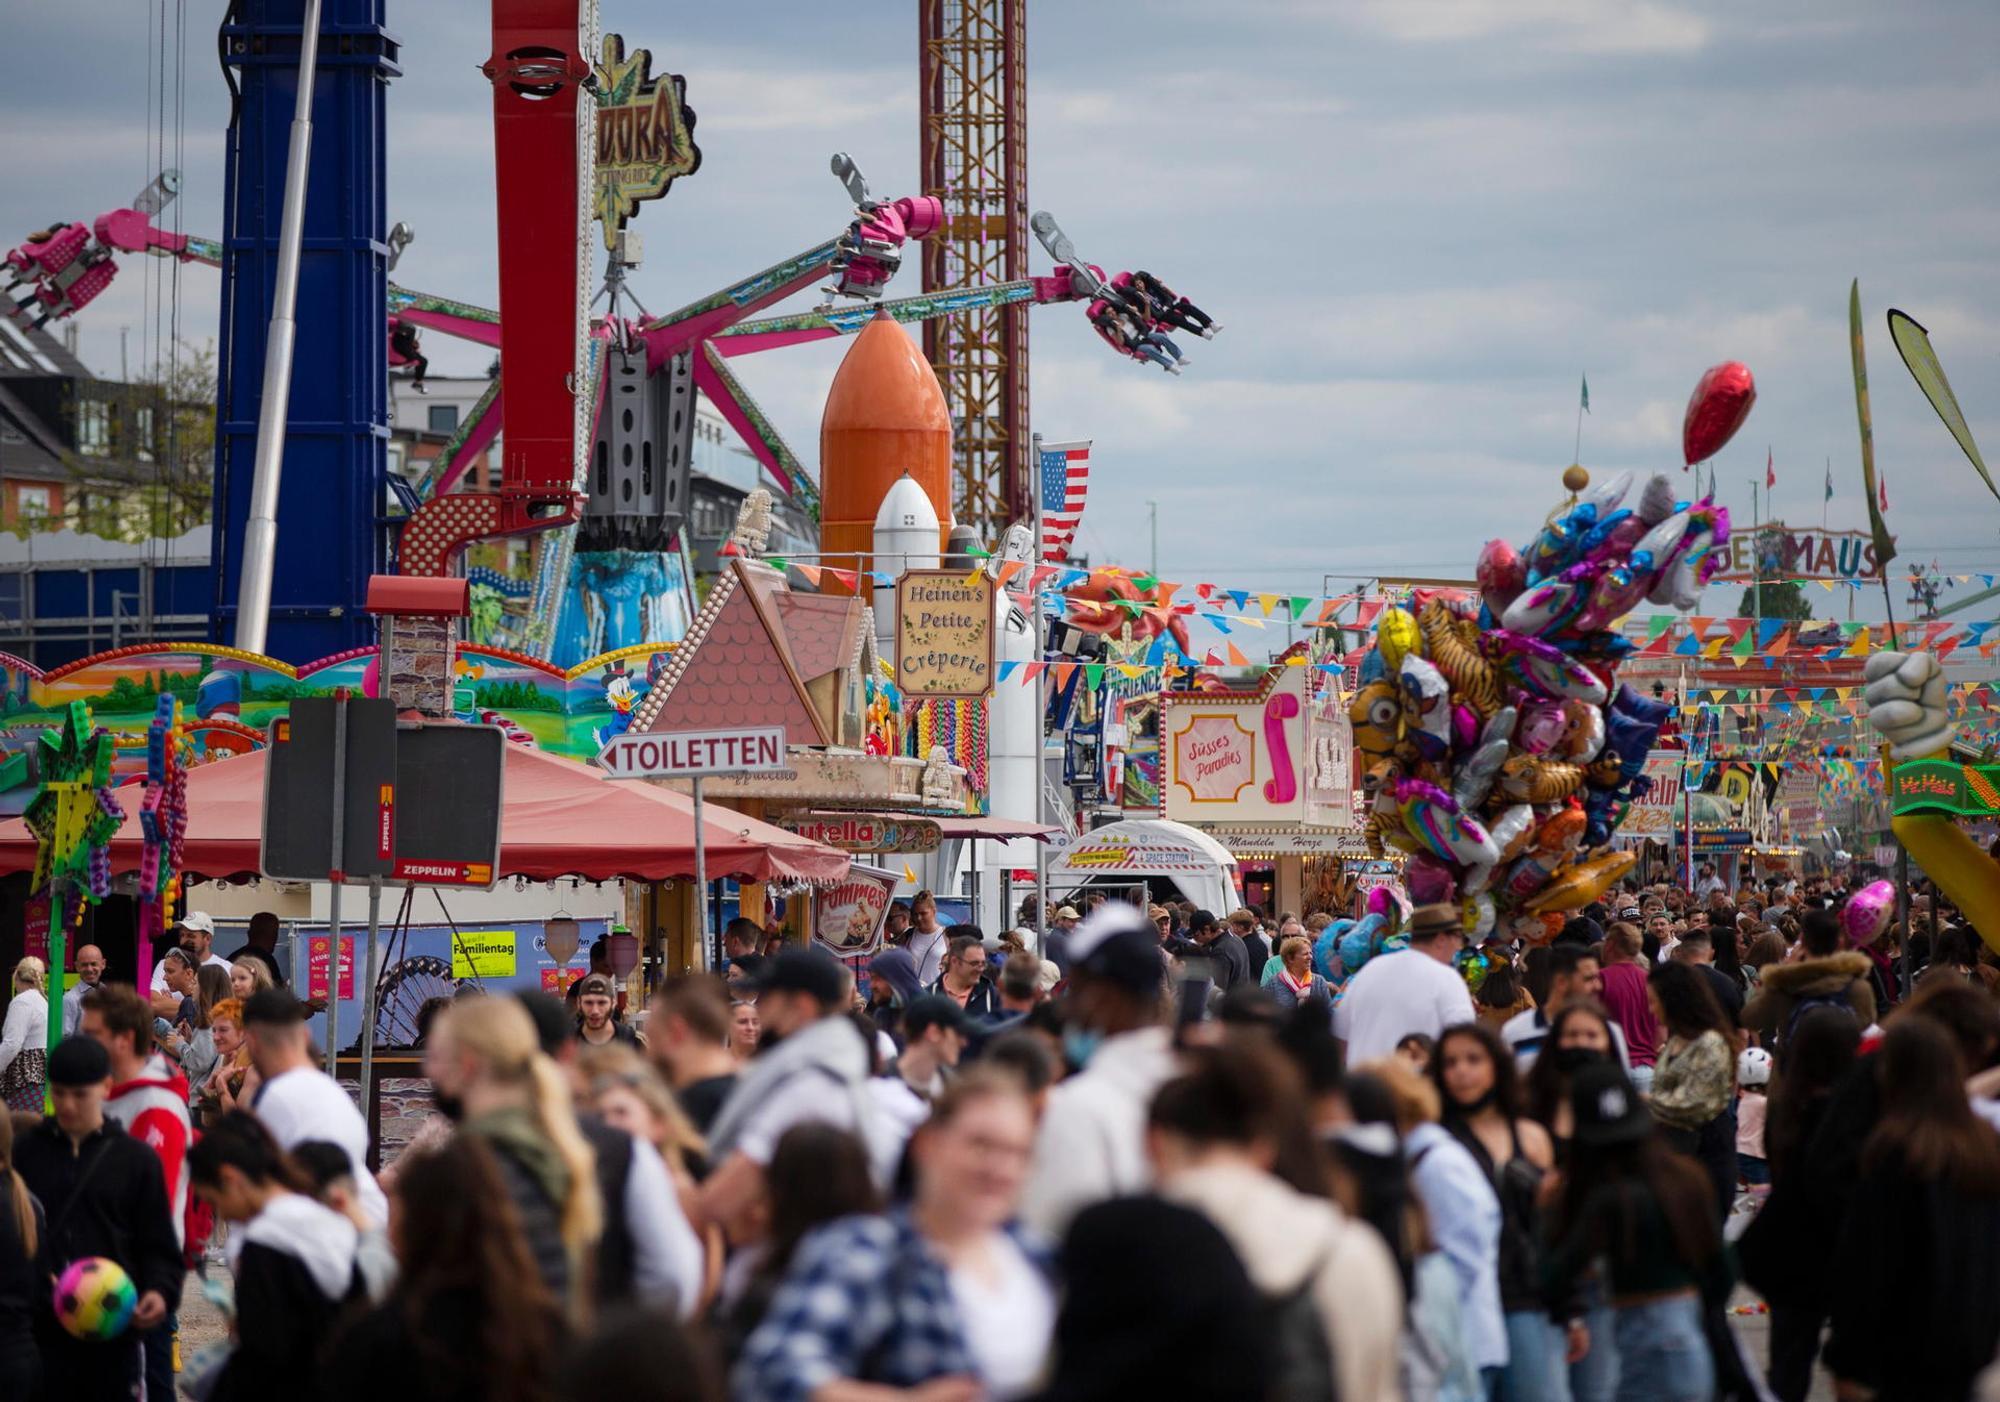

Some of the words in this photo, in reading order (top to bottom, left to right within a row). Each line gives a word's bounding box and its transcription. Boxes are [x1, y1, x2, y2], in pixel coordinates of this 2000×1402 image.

[597, 84, 688, 166] DORA
[1784, 535, 1878, 578] MAUS
[910, 586, 984, 602] Heinen's
[920, 612, 973, 629] Petite
[903, 650, 986, 675] Crêperie
[621, 735, 778, 771] TOILETTEN
[1188, 735, 1230, 760] Süsses
[1195, 751, 1242, 781] Paradies
[382, 811, 390, 851] ZEPPELIN
[1227, 835, 1276, 847] Mandeln
[1337, 837, 1368, 850] Zucke
[1145, 853, 1164, 863] SPACE
[1165, 852, 1189, 863] STATION
[403, 865, 457, 877] ZEPPELIN
[819, 883, 887, 915] Pommes
[454, 943, 514, 956] Familientag
